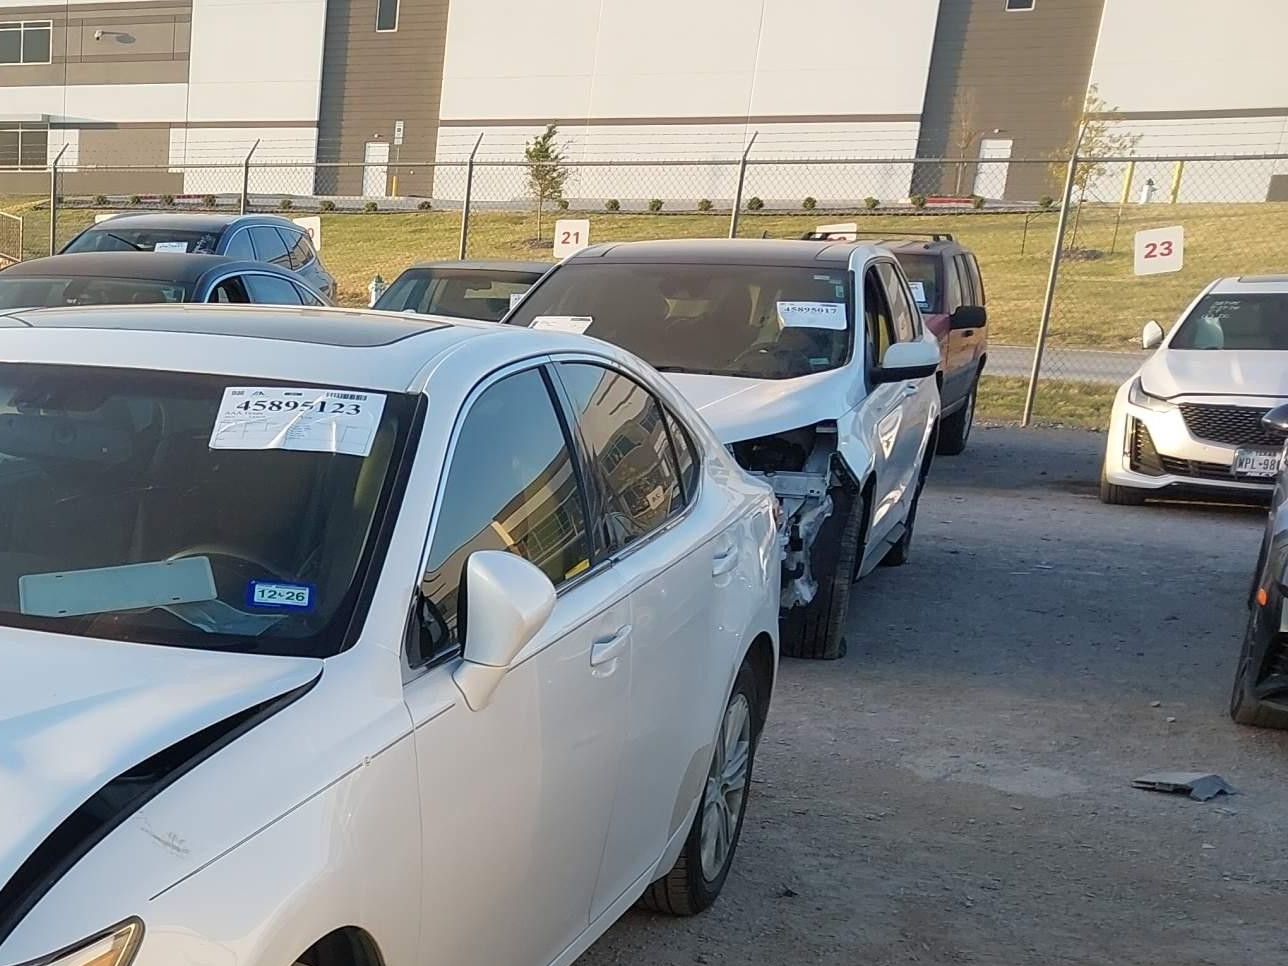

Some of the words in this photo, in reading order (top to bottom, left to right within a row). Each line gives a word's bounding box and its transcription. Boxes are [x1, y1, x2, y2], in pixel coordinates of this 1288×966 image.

[561, 231, 580, 245] 21
[1144, 240, 1173, 259] 23
[236, 400, 361, 416] 45895123
